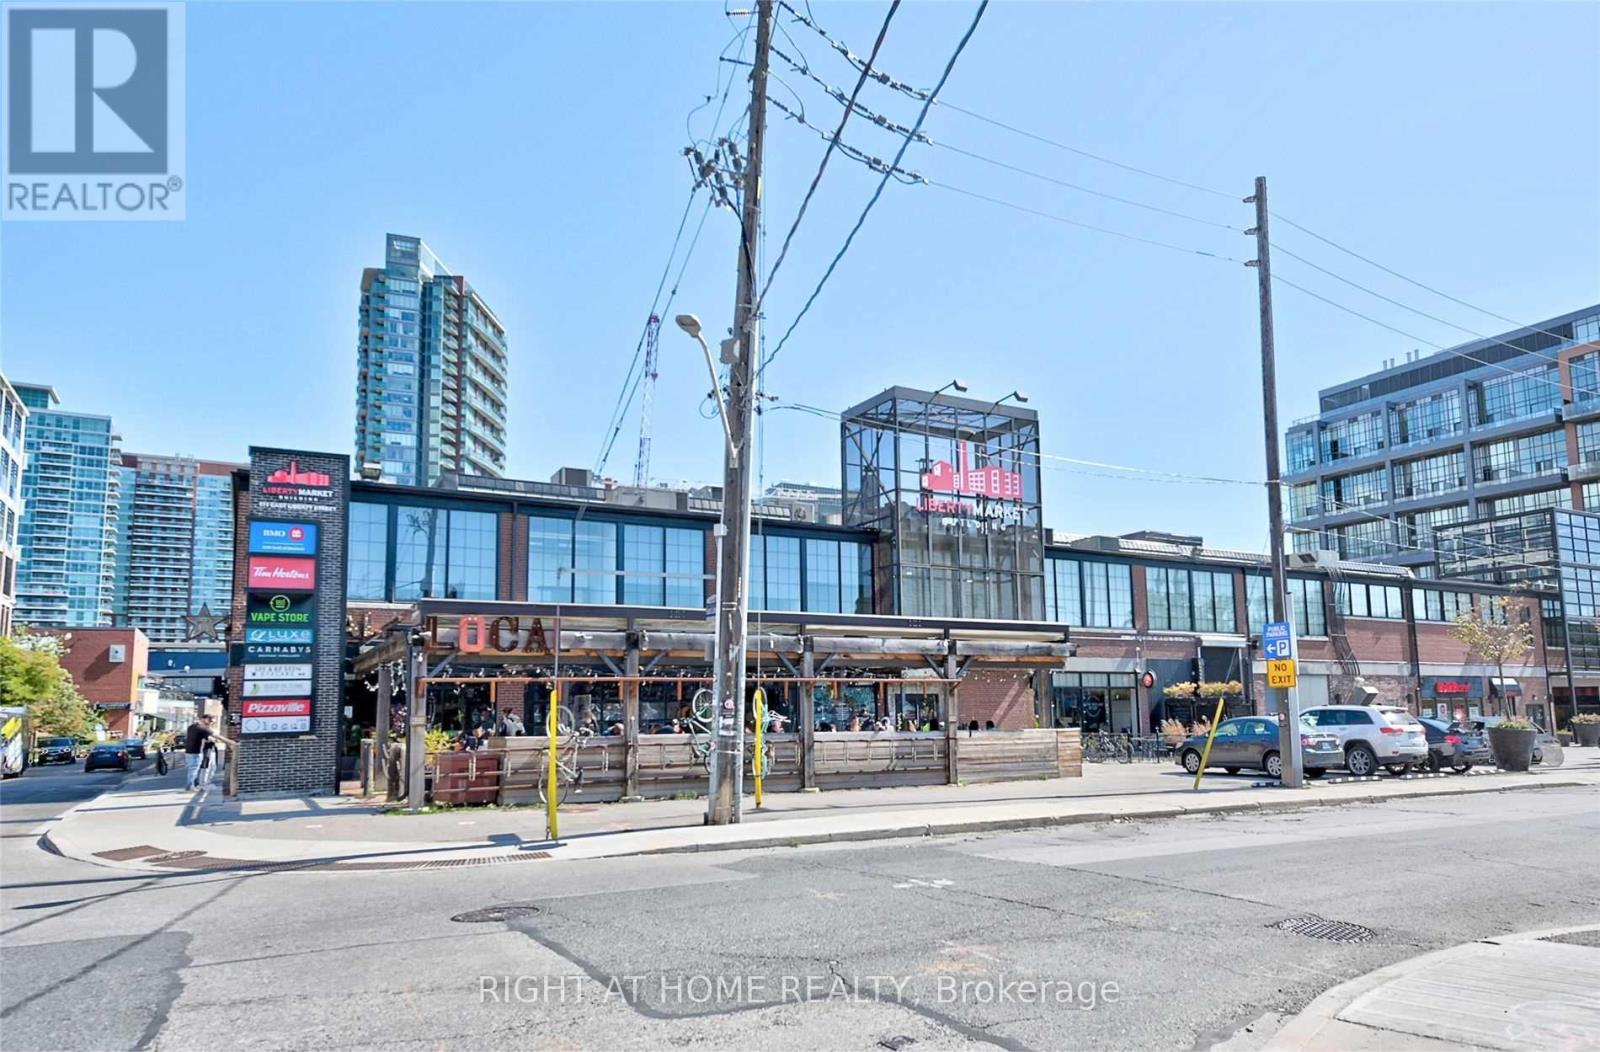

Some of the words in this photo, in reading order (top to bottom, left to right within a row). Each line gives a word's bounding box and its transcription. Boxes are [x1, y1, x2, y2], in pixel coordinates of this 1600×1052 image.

[263, 529, 286, 537] BMO
[254, 566, 272, 577] Tim
[272, 567, 309, 579] Hortons
[251, 612, 276, 622] VAPE
[278, 613, 309, 622] STORE
[1272, 675, 1291, 684] EXIT
[248, 703, 304, 713] Pizzaville
